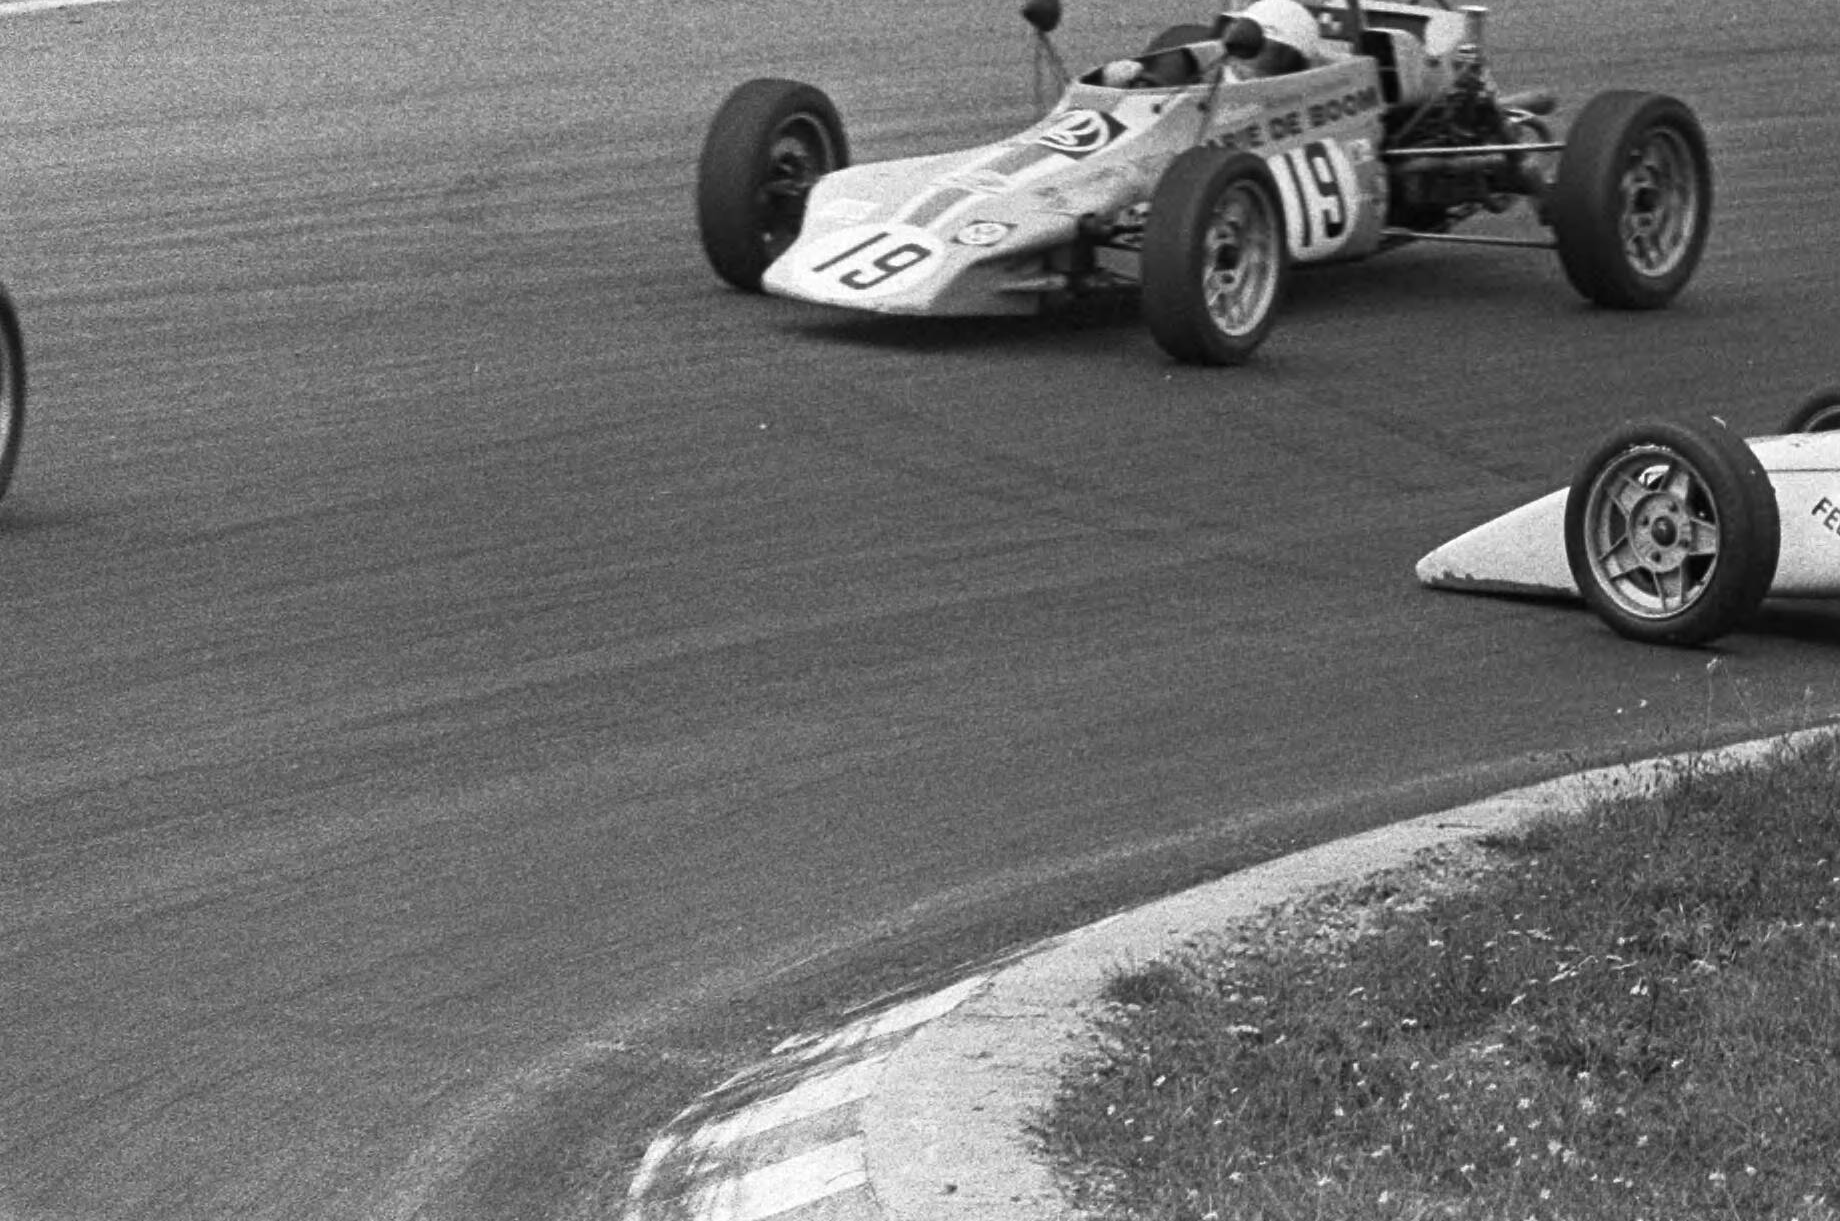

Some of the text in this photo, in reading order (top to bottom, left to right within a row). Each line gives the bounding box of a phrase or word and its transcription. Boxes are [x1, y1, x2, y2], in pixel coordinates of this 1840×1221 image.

[1269, 110, 1303, 140] DE
[1309, 86, 1378, 127] BOOM
[1283, 141, 1348, 248] 19
[812, 231, 932, 290] 19
